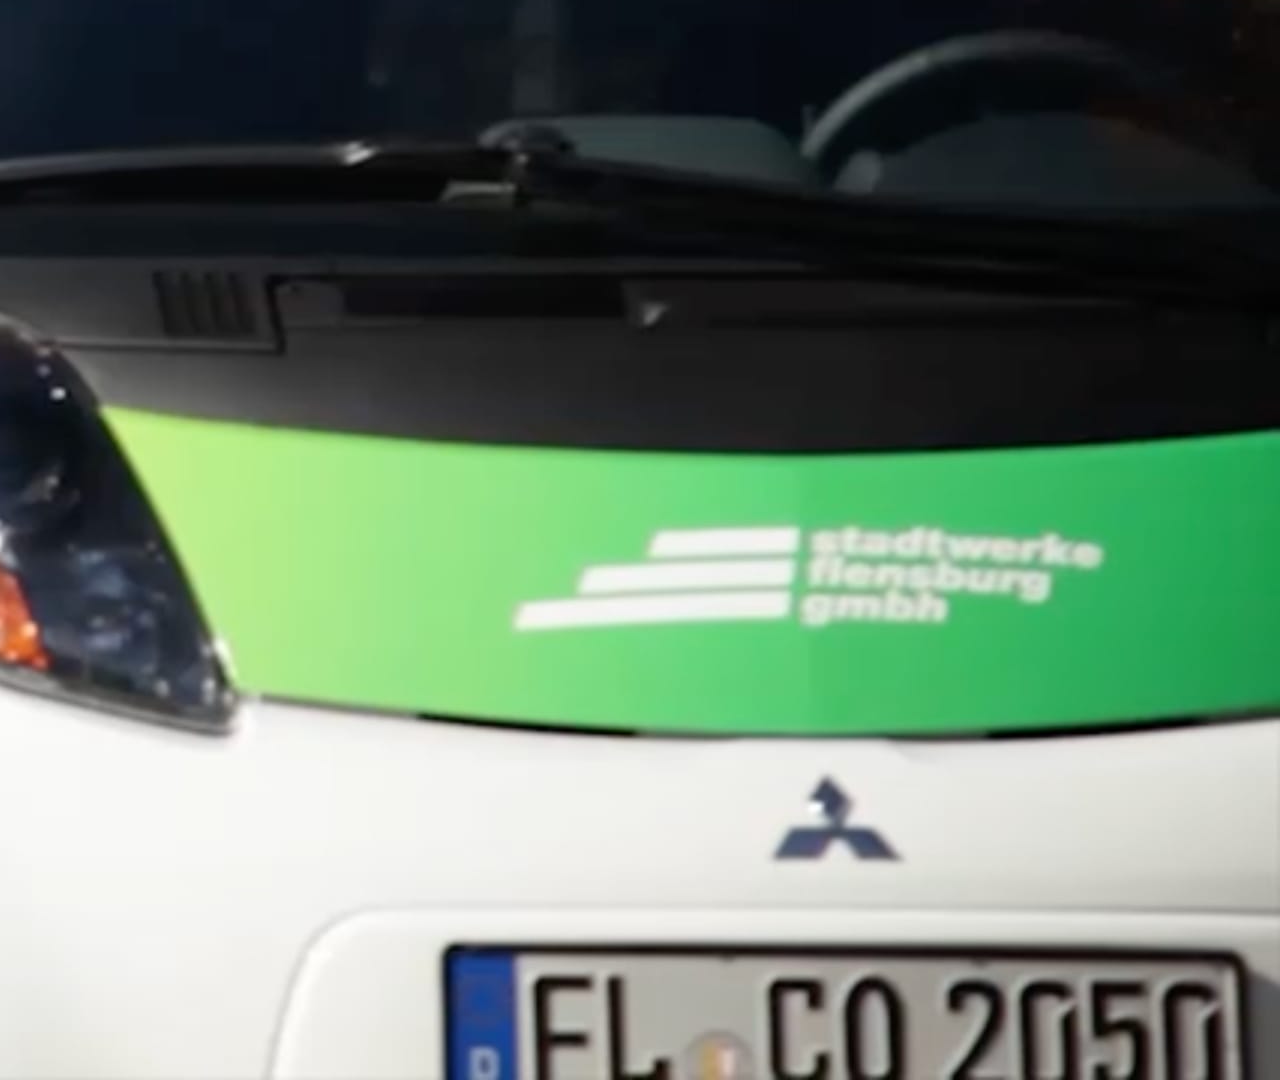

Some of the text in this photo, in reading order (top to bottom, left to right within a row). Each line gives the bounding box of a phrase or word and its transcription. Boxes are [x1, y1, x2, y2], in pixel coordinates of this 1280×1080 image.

[808, 525, 1104, 569] stadtwerke
[806, 556, 1053, 603] flensburg
[799, 588, 949, 630] gmbh
[946, 977, 1226, 1080] 2050
